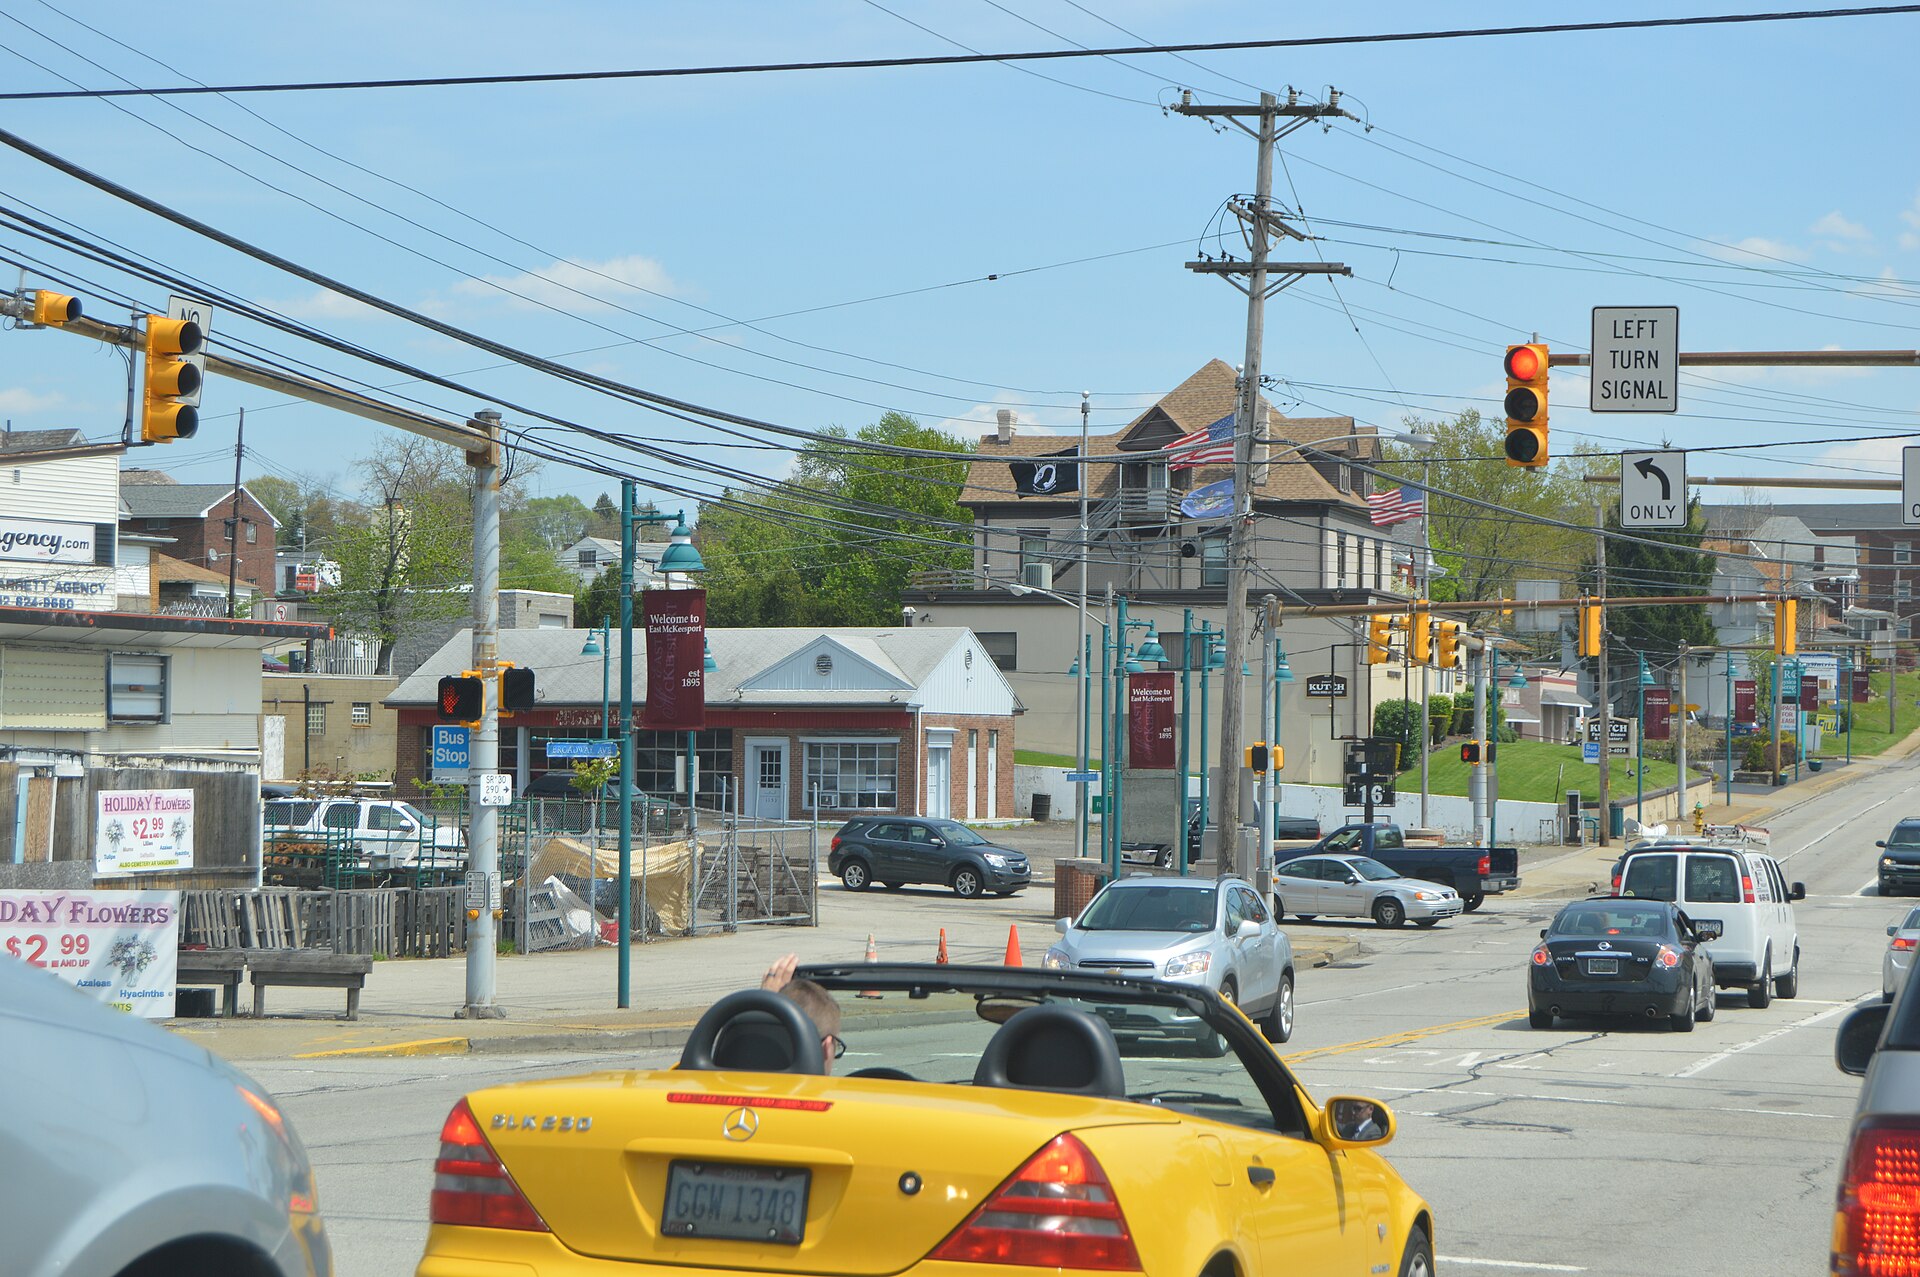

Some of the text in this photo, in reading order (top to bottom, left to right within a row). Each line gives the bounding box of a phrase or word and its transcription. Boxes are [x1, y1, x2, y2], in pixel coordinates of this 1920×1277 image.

[1613, 319, 1658, 339] LEFT
[1609, 350, 1659, 369] TURN
[1601, 380, 1668, 400] SIGNAL
[1630, 505, 1677, 519] ONLY
[0, 531, 90, 556] gency.com
[54, 581, 107, 595] AGENCY
[650, 614, 700, 624] Welcome to
[649, 625, 702, 634] East McKeesport
[688, 669, 700, 678] est
[681, 678, 700, 687] 1895
[1309, 683, 1345, 691] KUTCH
[1132, 688, 1162, 696] Welcome
[438, 730, 465, 745] Bus
[551, 745, 594, 754] BROADWAY
[1585, 750, 1599, 758] Stop
[436, 747, 467, 765] Stop
[485, 775, 507, 784] SR 30
[485, 785, 499, 794] 290
[1359, 784, 1383, 804] 16
[104, 794, 153, 813] HOLIDAY
[492, 795, 504, 804] 291
[133, 817, 164, 840] $2.99
[6, 933, 90, 968] $2.99
[60, 958, 90, 968] AND UP
[76, 979, 112, 988] Azaleas
[119, 989, 165, 998] Hyacinths
[723, 1168, 758, 1180] OHIO
[731, 1185, 797, 1226] 1348
